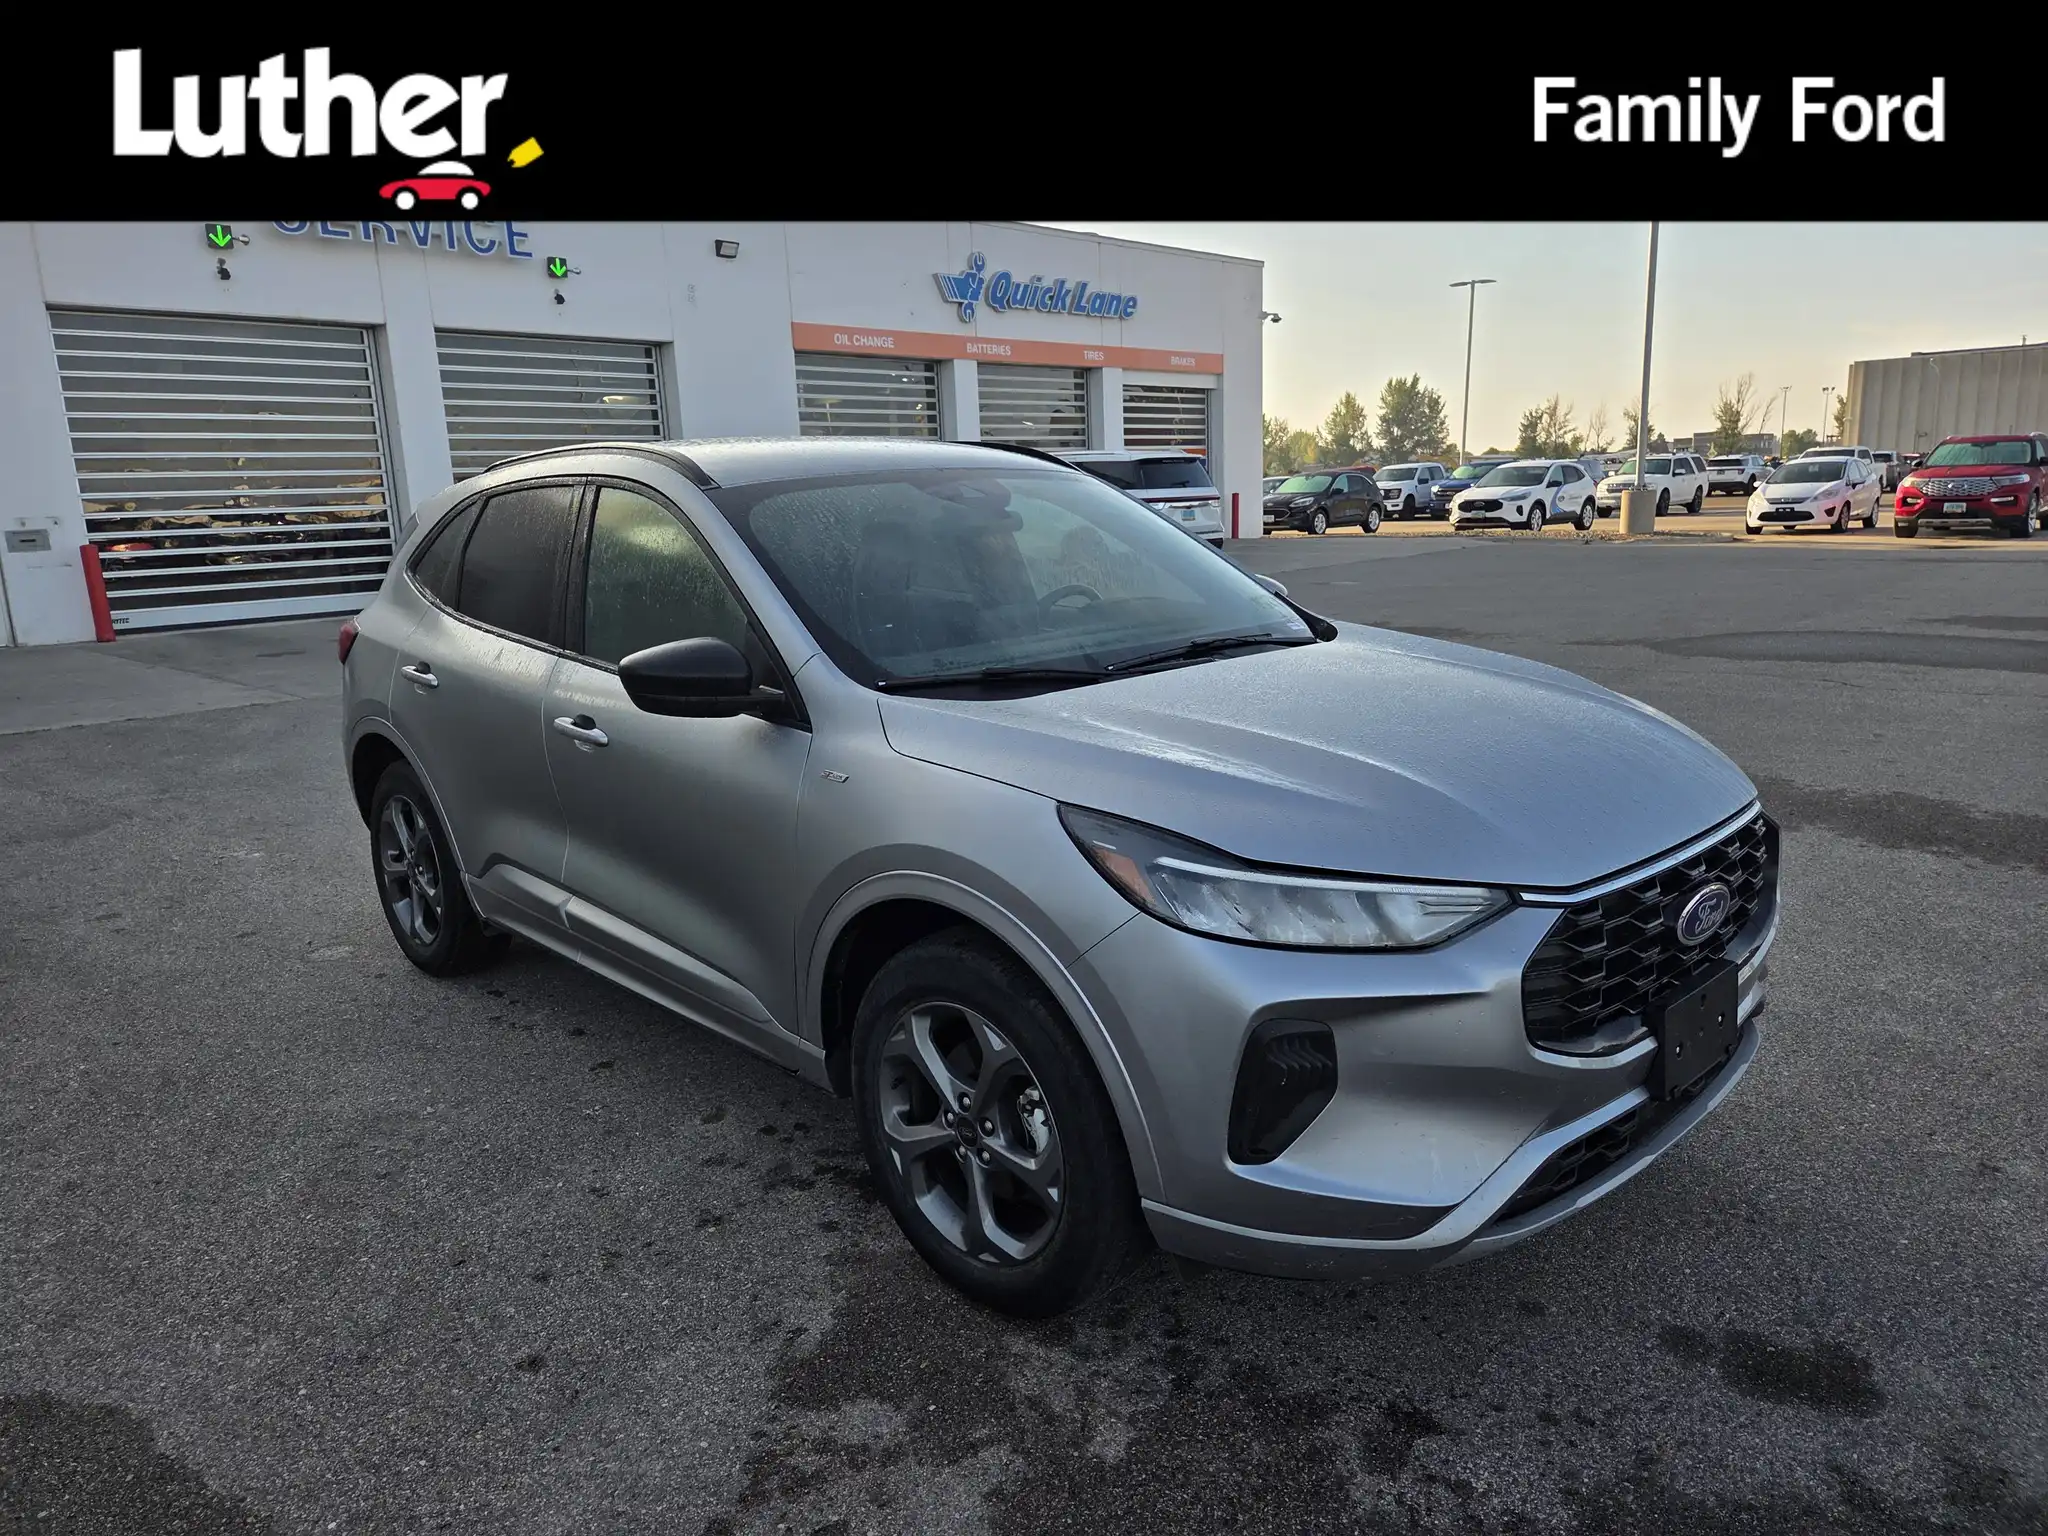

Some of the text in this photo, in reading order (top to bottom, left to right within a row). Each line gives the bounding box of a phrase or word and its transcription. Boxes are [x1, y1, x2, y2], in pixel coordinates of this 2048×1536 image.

[987, 270, 1138, 319] Quick Lane
[834, 333, 895, 349] OIL CHANGE
[966, 342, 1012, 356] BATTERIES
[1083, 350, 1105, 361] TIRES
[1170, 356, 1196, 367] BRAKES
[1695, 898, 1724, 934] Ford
